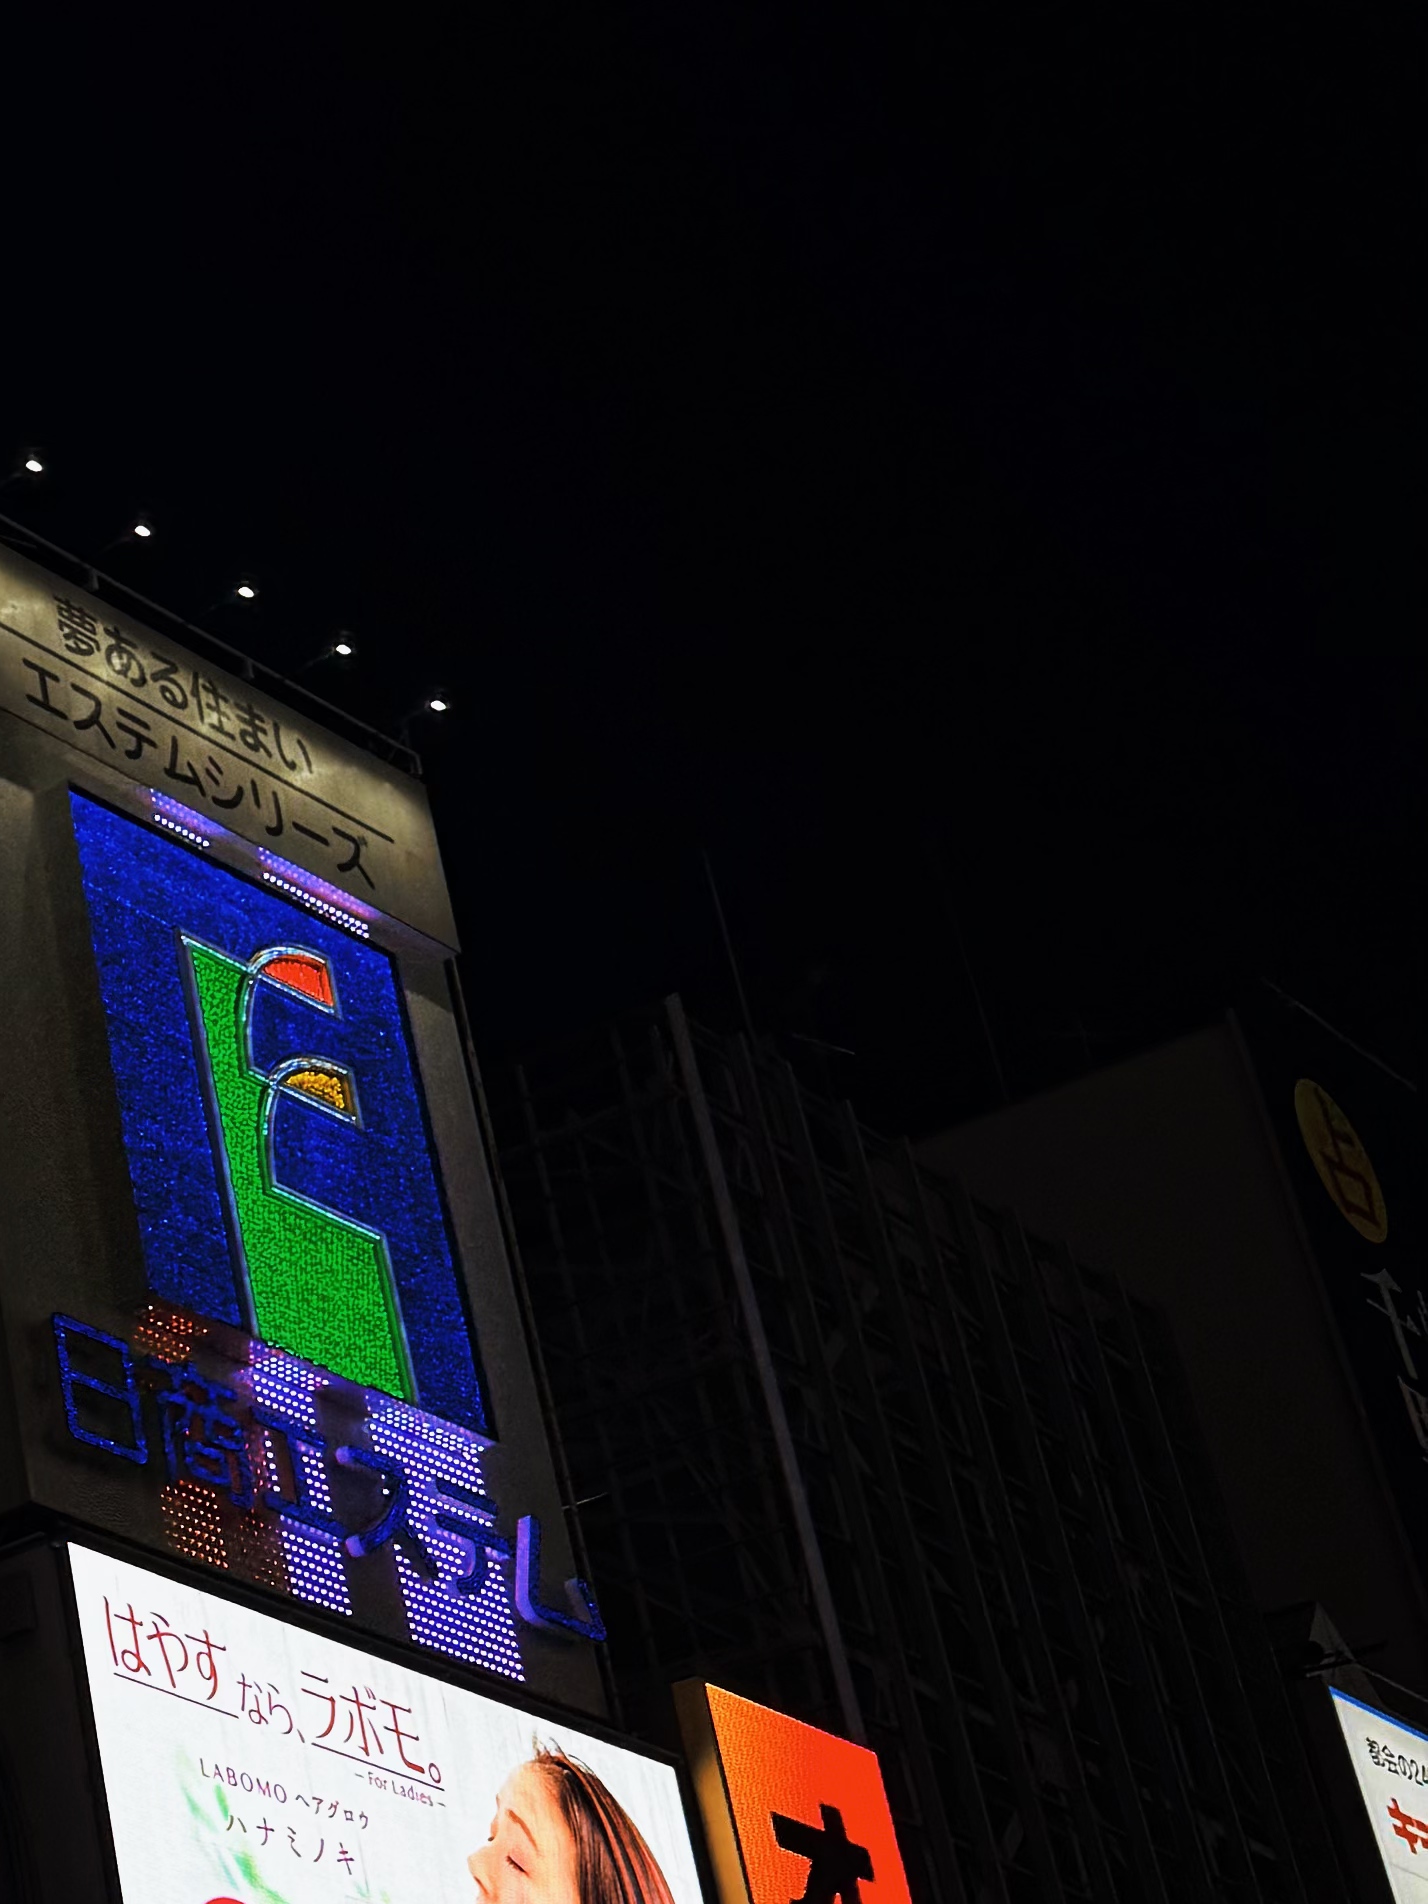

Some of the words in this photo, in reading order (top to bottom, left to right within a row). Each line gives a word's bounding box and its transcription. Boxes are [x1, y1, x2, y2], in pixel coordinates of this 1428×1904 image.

[53, 595, 314, 774] 夢ある住まい
[22, 657, 375, 890] エステムシリーズ
[199, 1757, 288, 1804] LABOMO
[295, 1794, 370, 1830] ヘアグロウ
[226, 1815, 356, 1875] ハナミノキ
